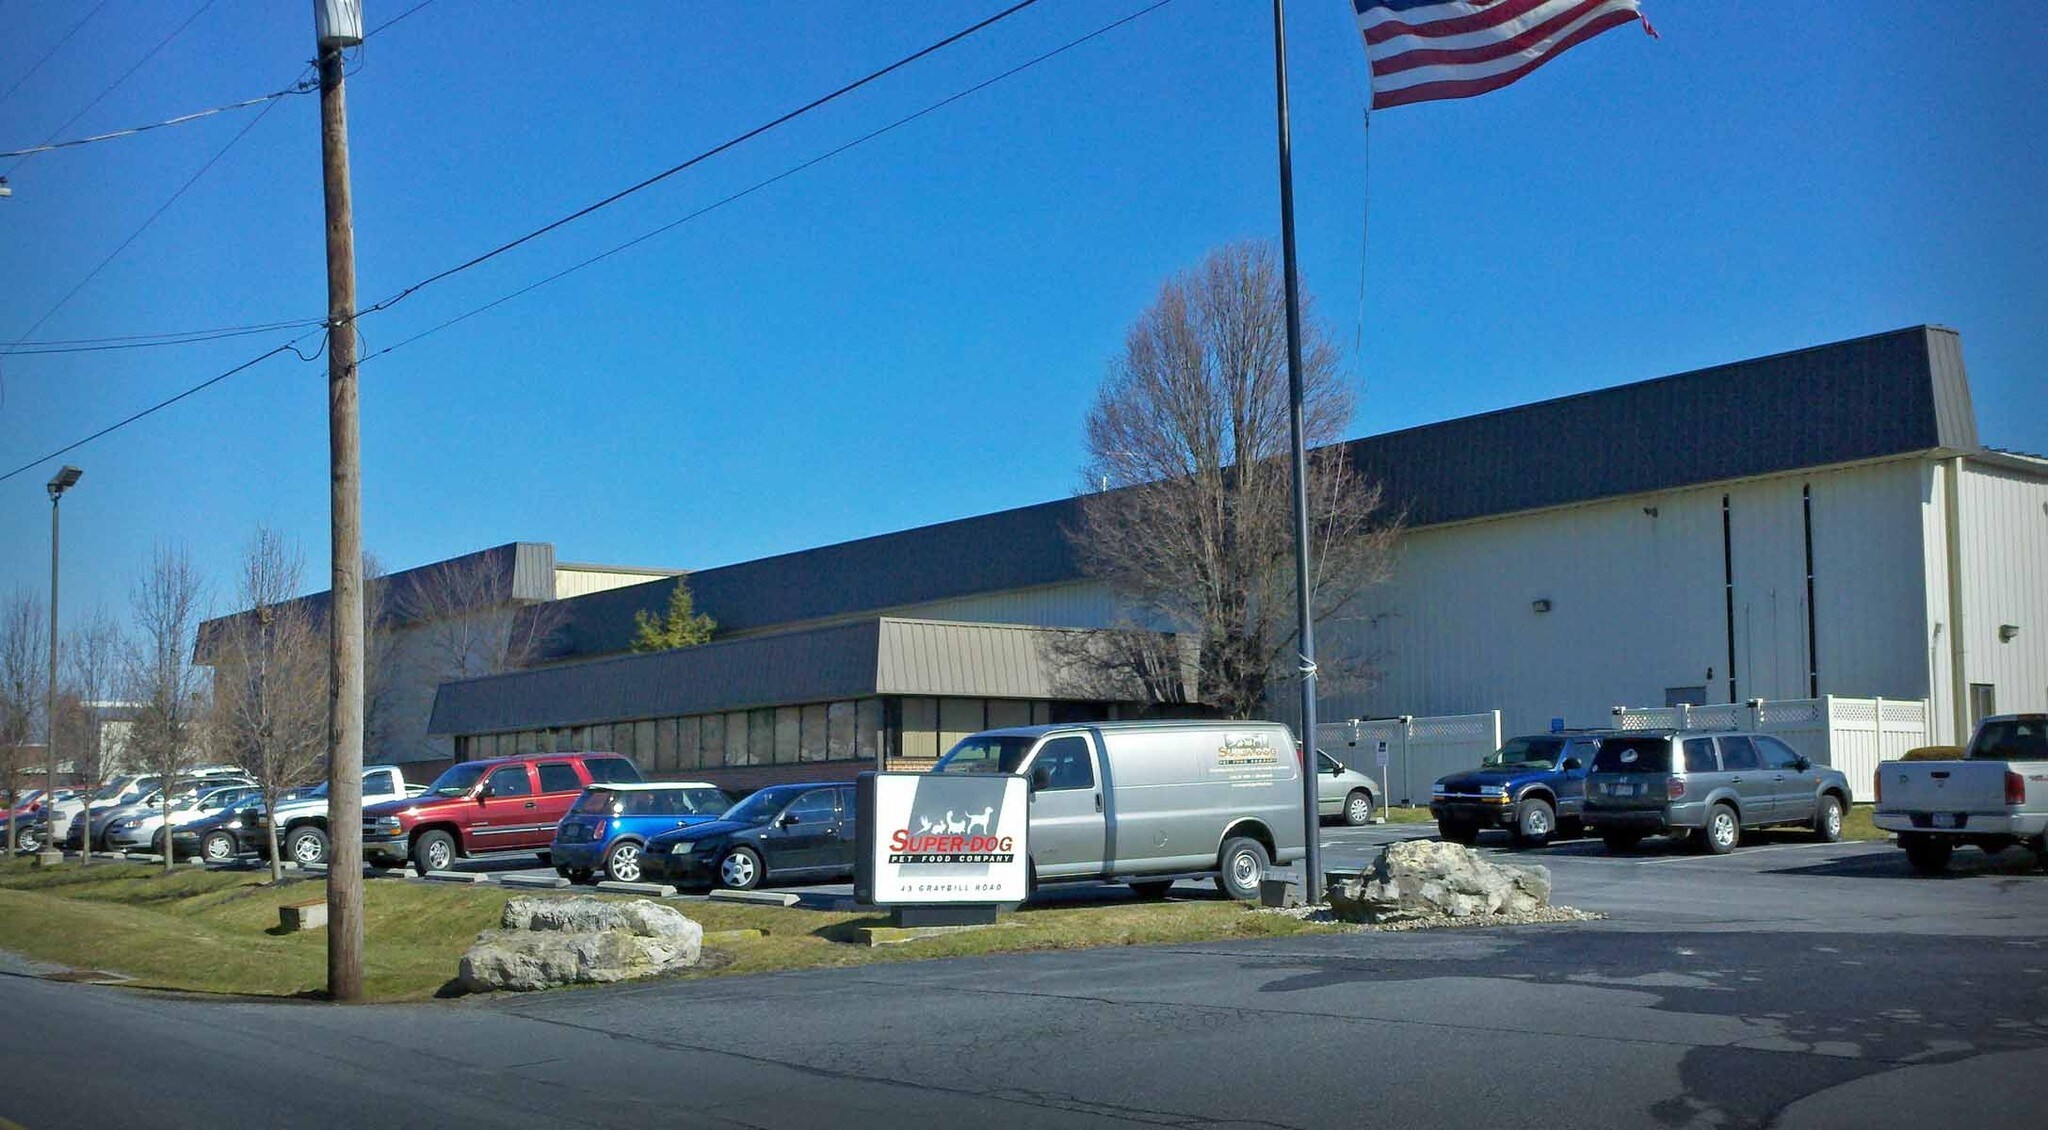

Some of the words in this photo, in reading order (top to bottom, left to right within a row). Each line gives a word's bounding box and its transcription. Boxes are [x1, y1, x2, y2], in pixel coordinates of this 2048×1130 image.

[889, 829, 1013, 852] SUPER-DOG
[891, 855, 914, 863] PET
[921, 855, 951, 863] FOOD
[918, 884, 969, 892] GRAYBILL
[975, 884, 1002, 892] ROAD
